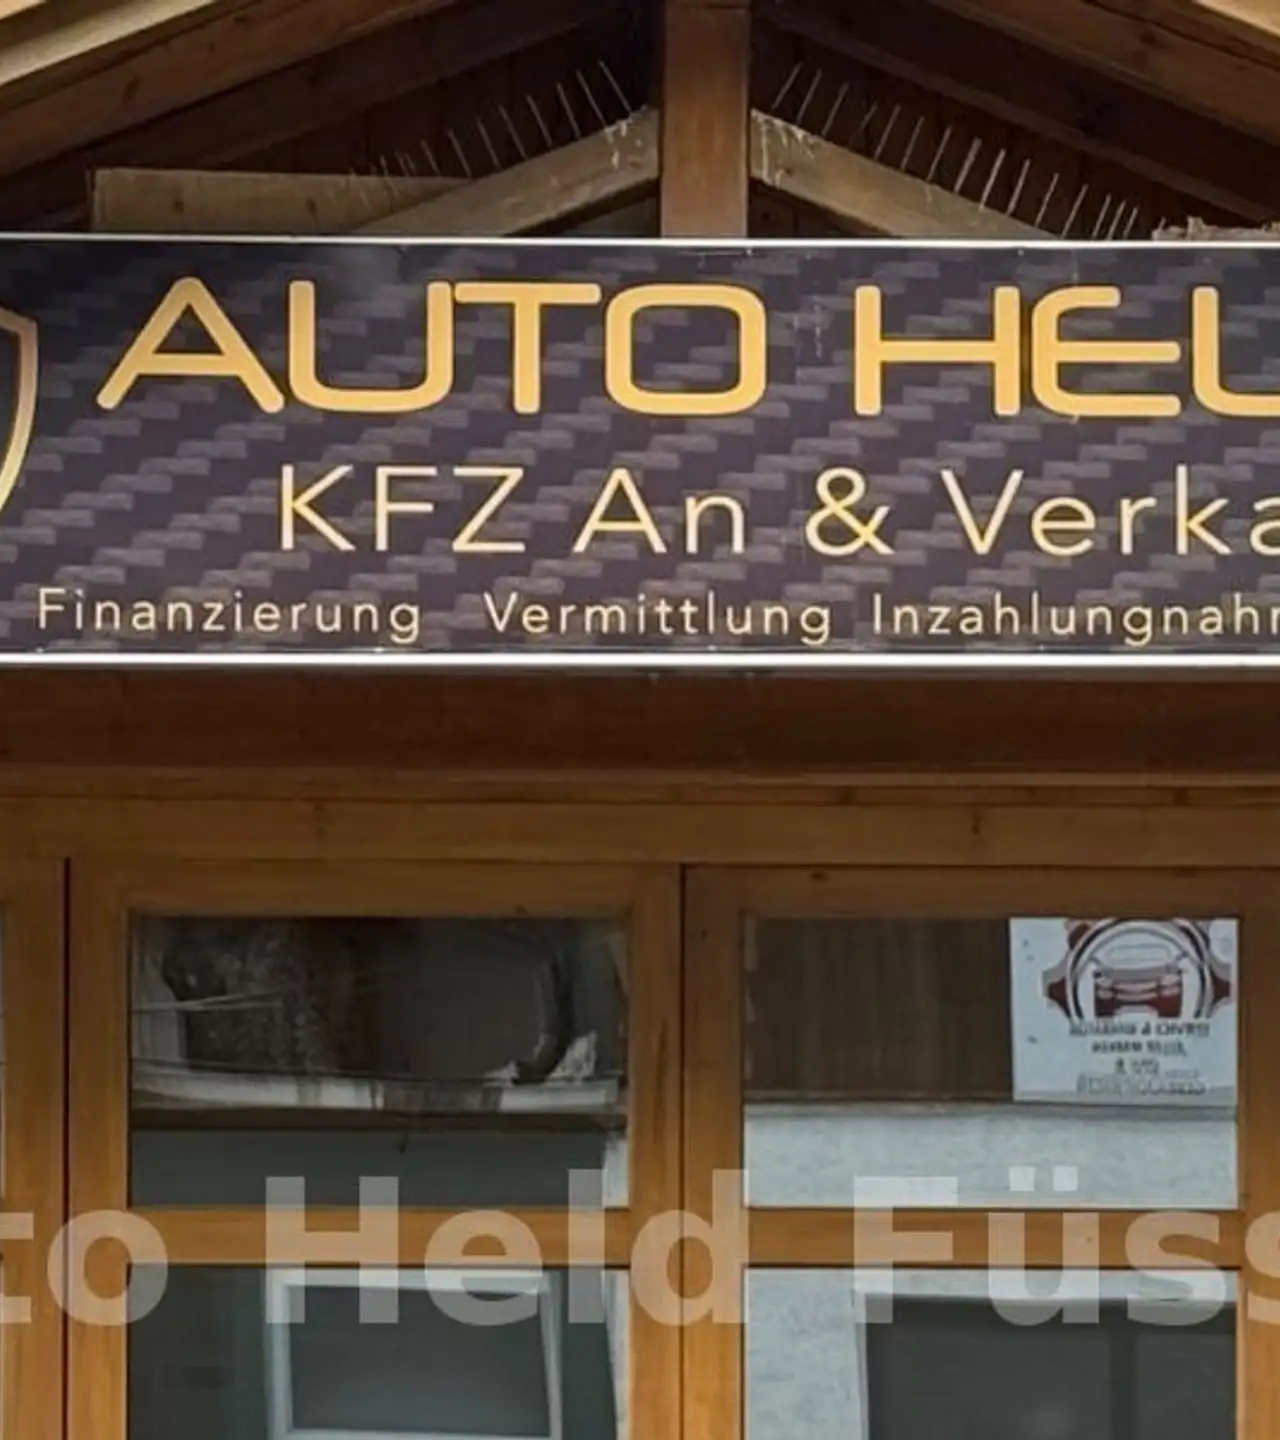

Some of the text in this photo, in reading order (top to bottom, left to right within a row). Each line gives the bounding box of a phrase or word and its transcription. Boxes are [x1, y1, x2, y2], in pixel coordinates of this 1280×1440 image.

[97, 278, 767, 415] AUTO
[280, 464, 526, 554] KFZ
[571, 466, 745, 556] An
[804, 466, 895, 557] &
[38, 587, 420, 644] Finanzierung
[483, 590, 830, 646] Vermittlung
